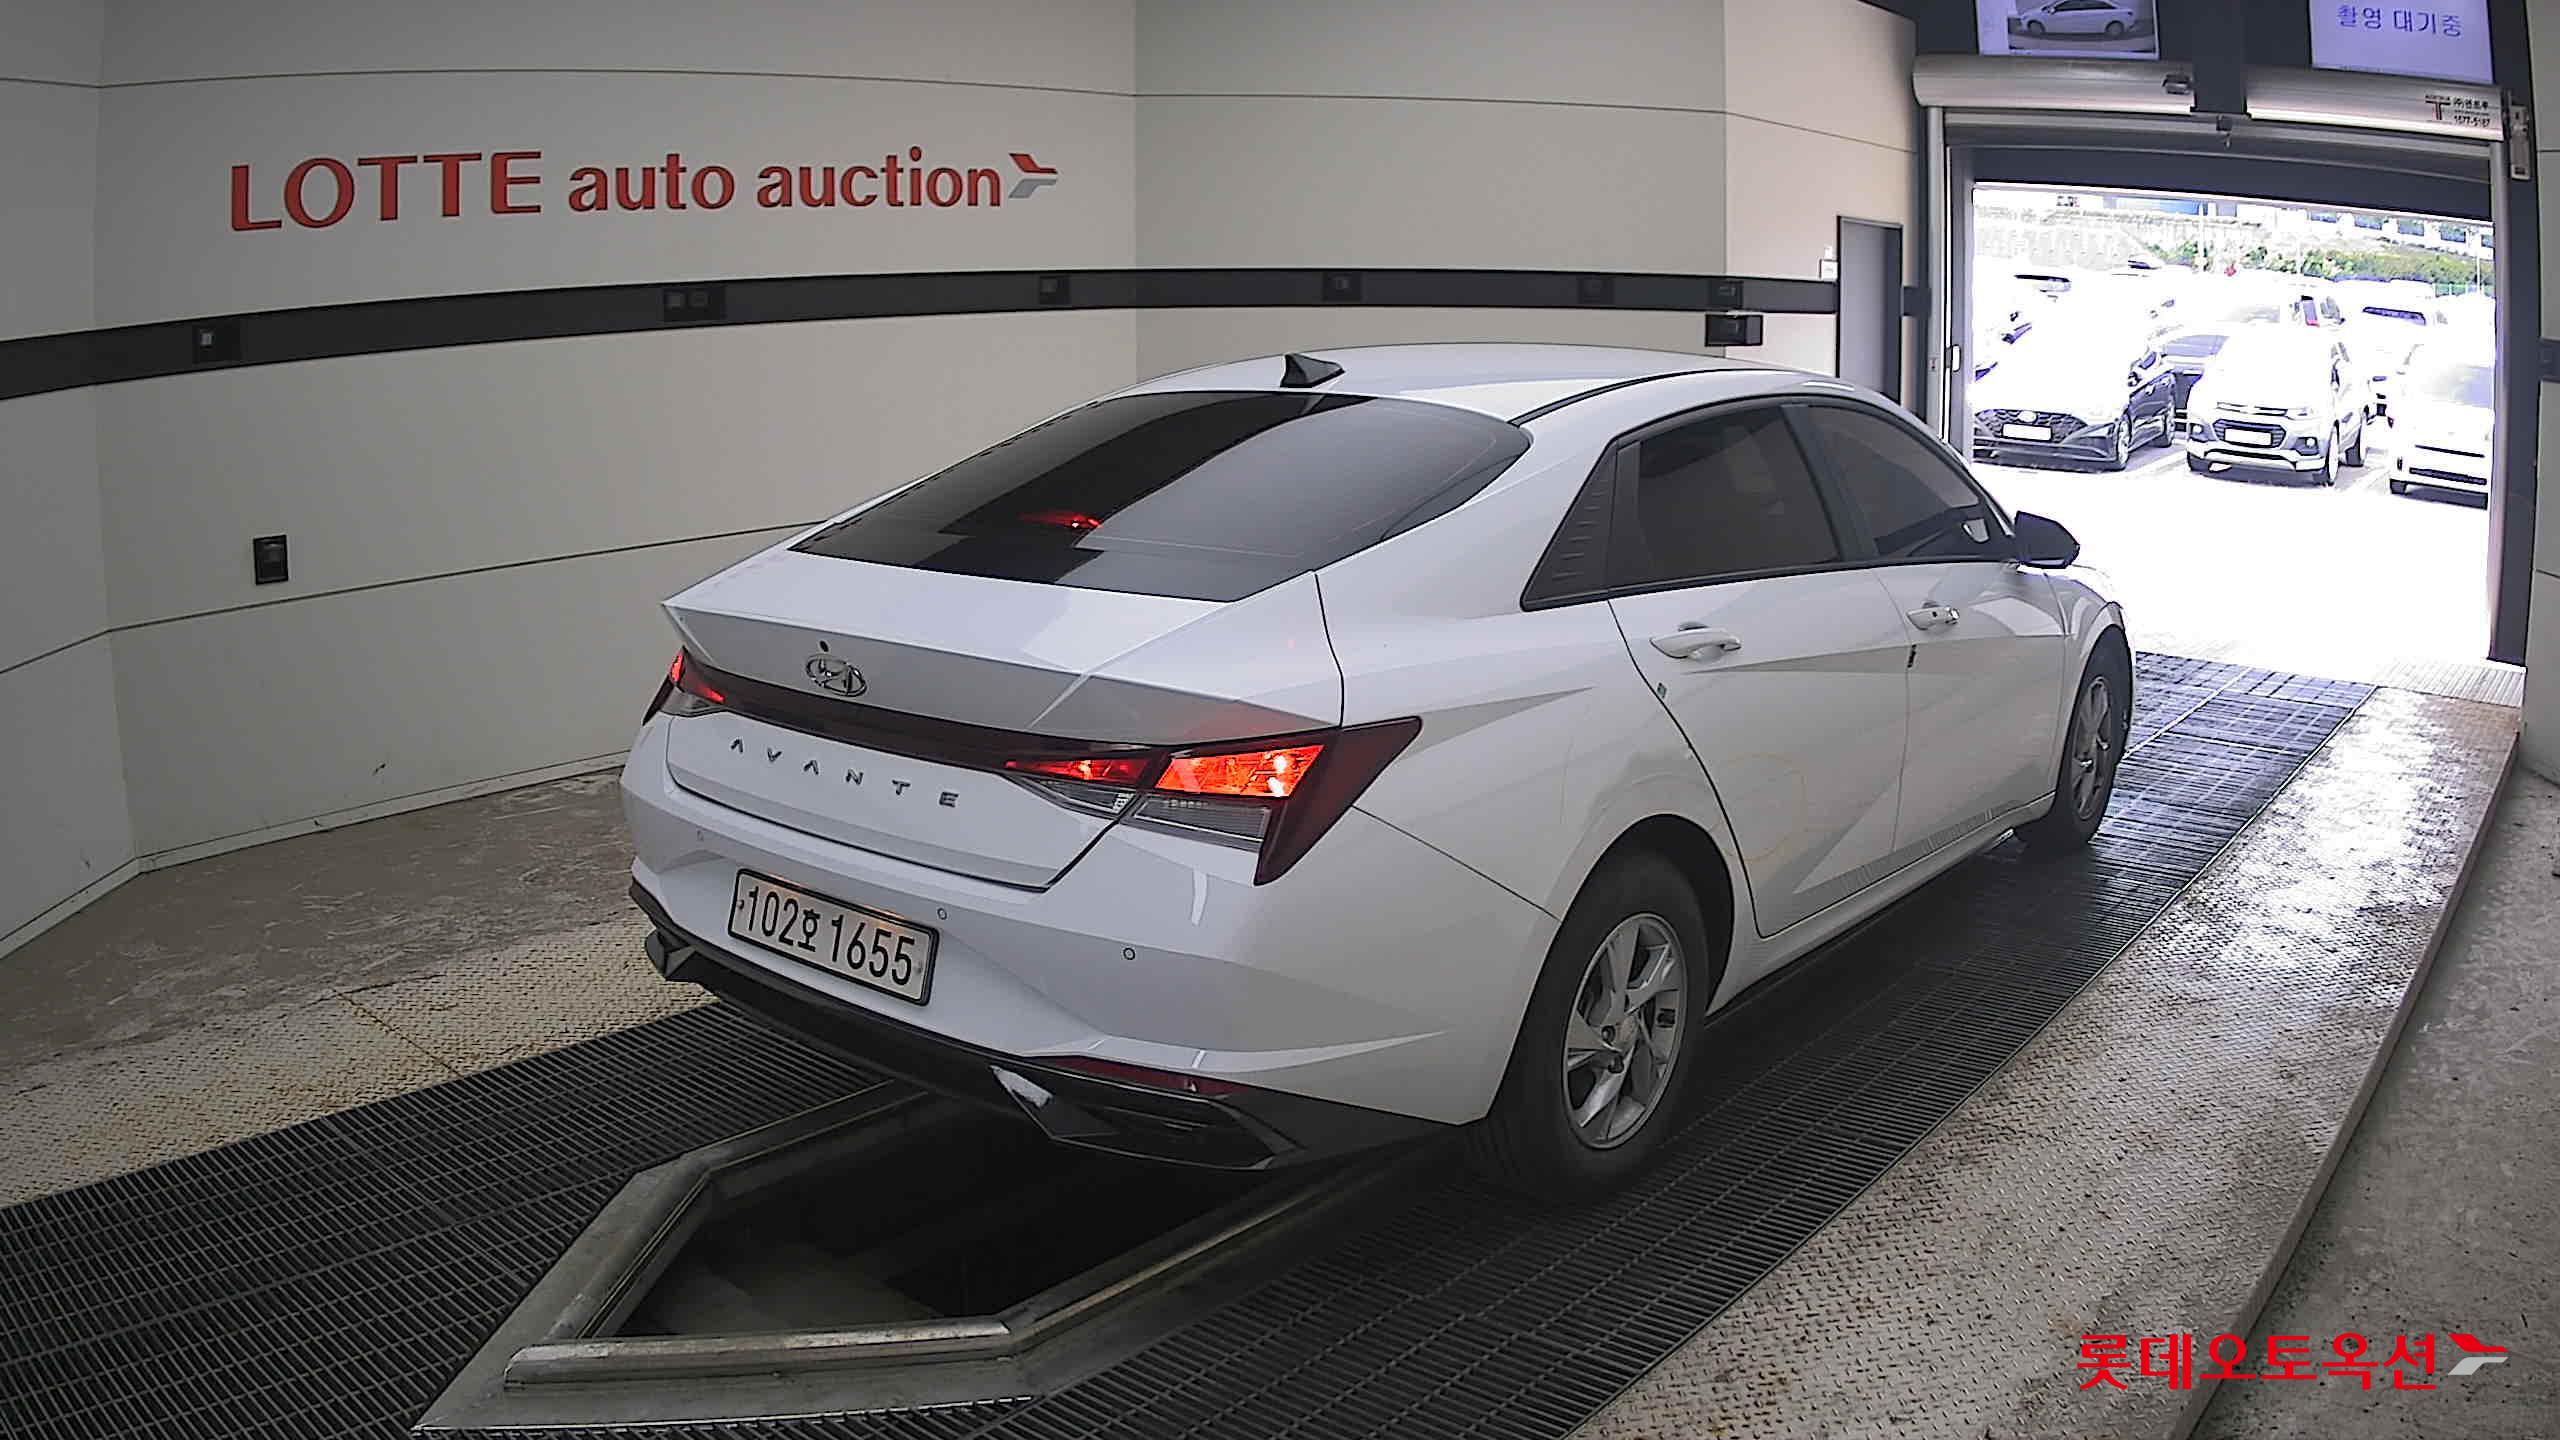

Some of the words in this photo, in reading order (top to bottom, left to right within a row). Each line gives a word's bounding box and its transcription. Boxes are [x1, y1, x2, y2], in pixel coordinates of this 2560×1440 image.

[2338, 5, 2382, 30] 촬영
[2393, 10, 2462, 38] 대기중
[231, 151, 541, 231] LOTTE
[568, 152, 736, 212] auto
[756, 146, 1001, 208] auction
[730, 738, 960, 808] AVANTE
